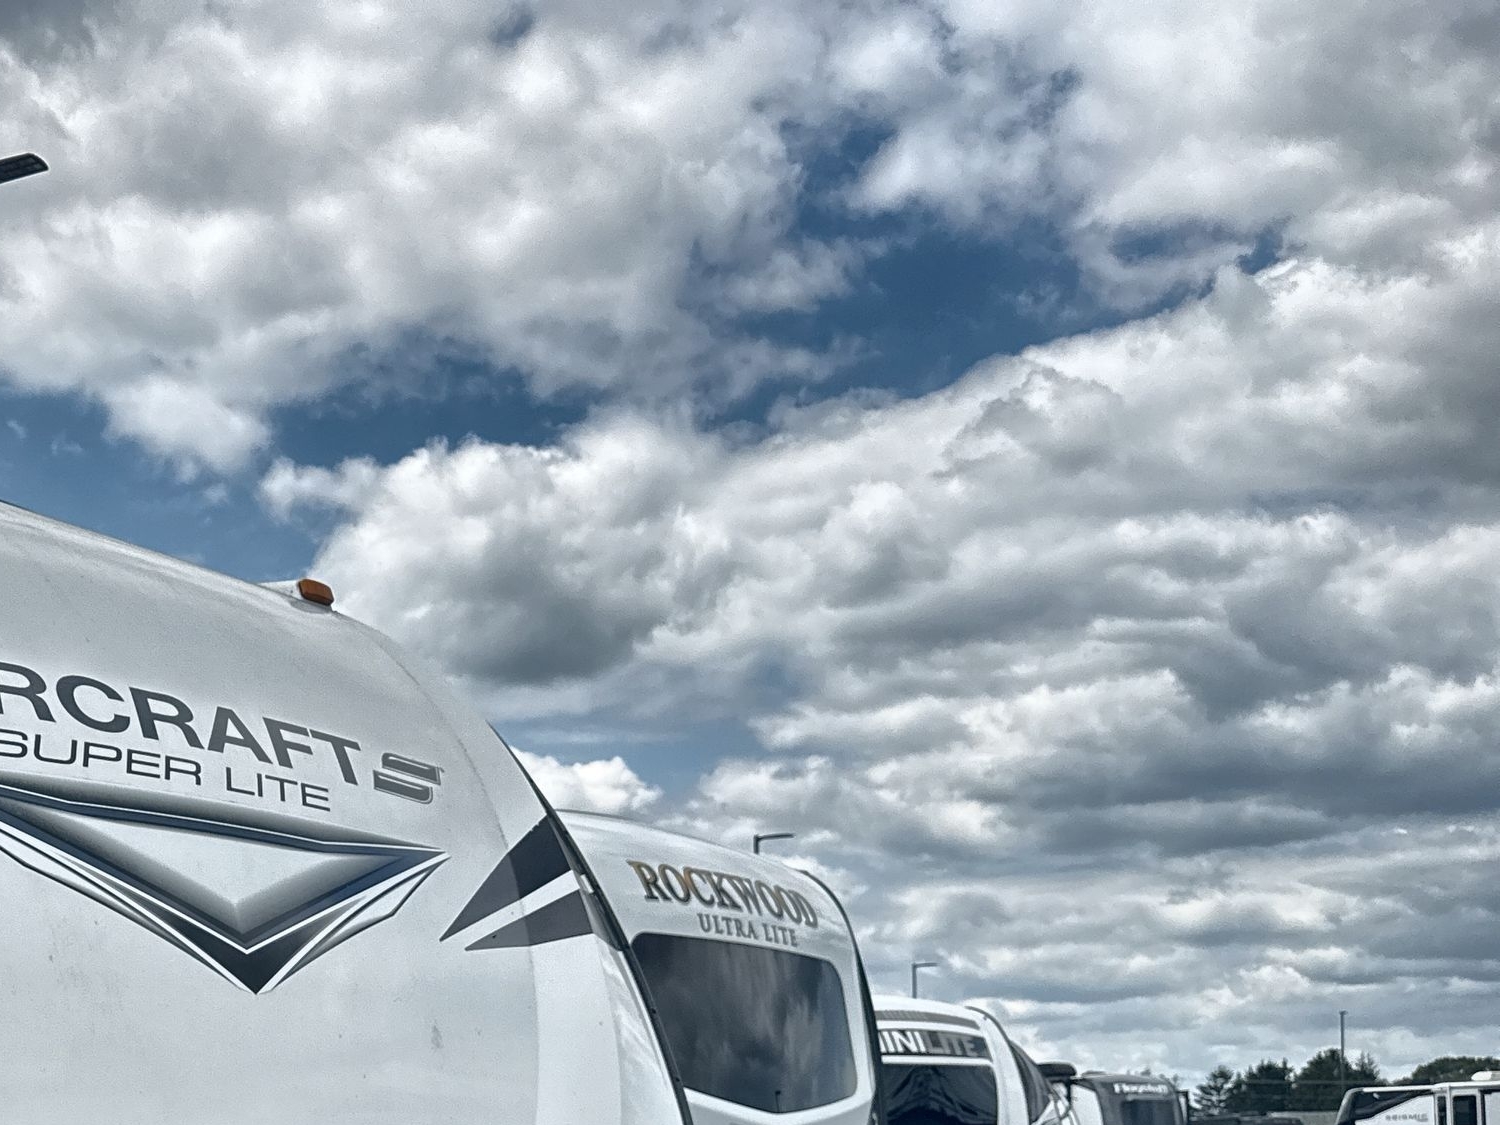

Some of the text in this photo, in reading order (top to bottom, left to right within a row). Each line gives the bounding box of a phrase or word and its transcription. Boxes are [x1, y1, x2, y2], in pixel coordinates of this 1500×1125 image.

[225, 766, 331, 812] LITE
[626, 859, 819, 930] ROCKWOOD
[697, 912, 799, 948] ULTRA LITE
